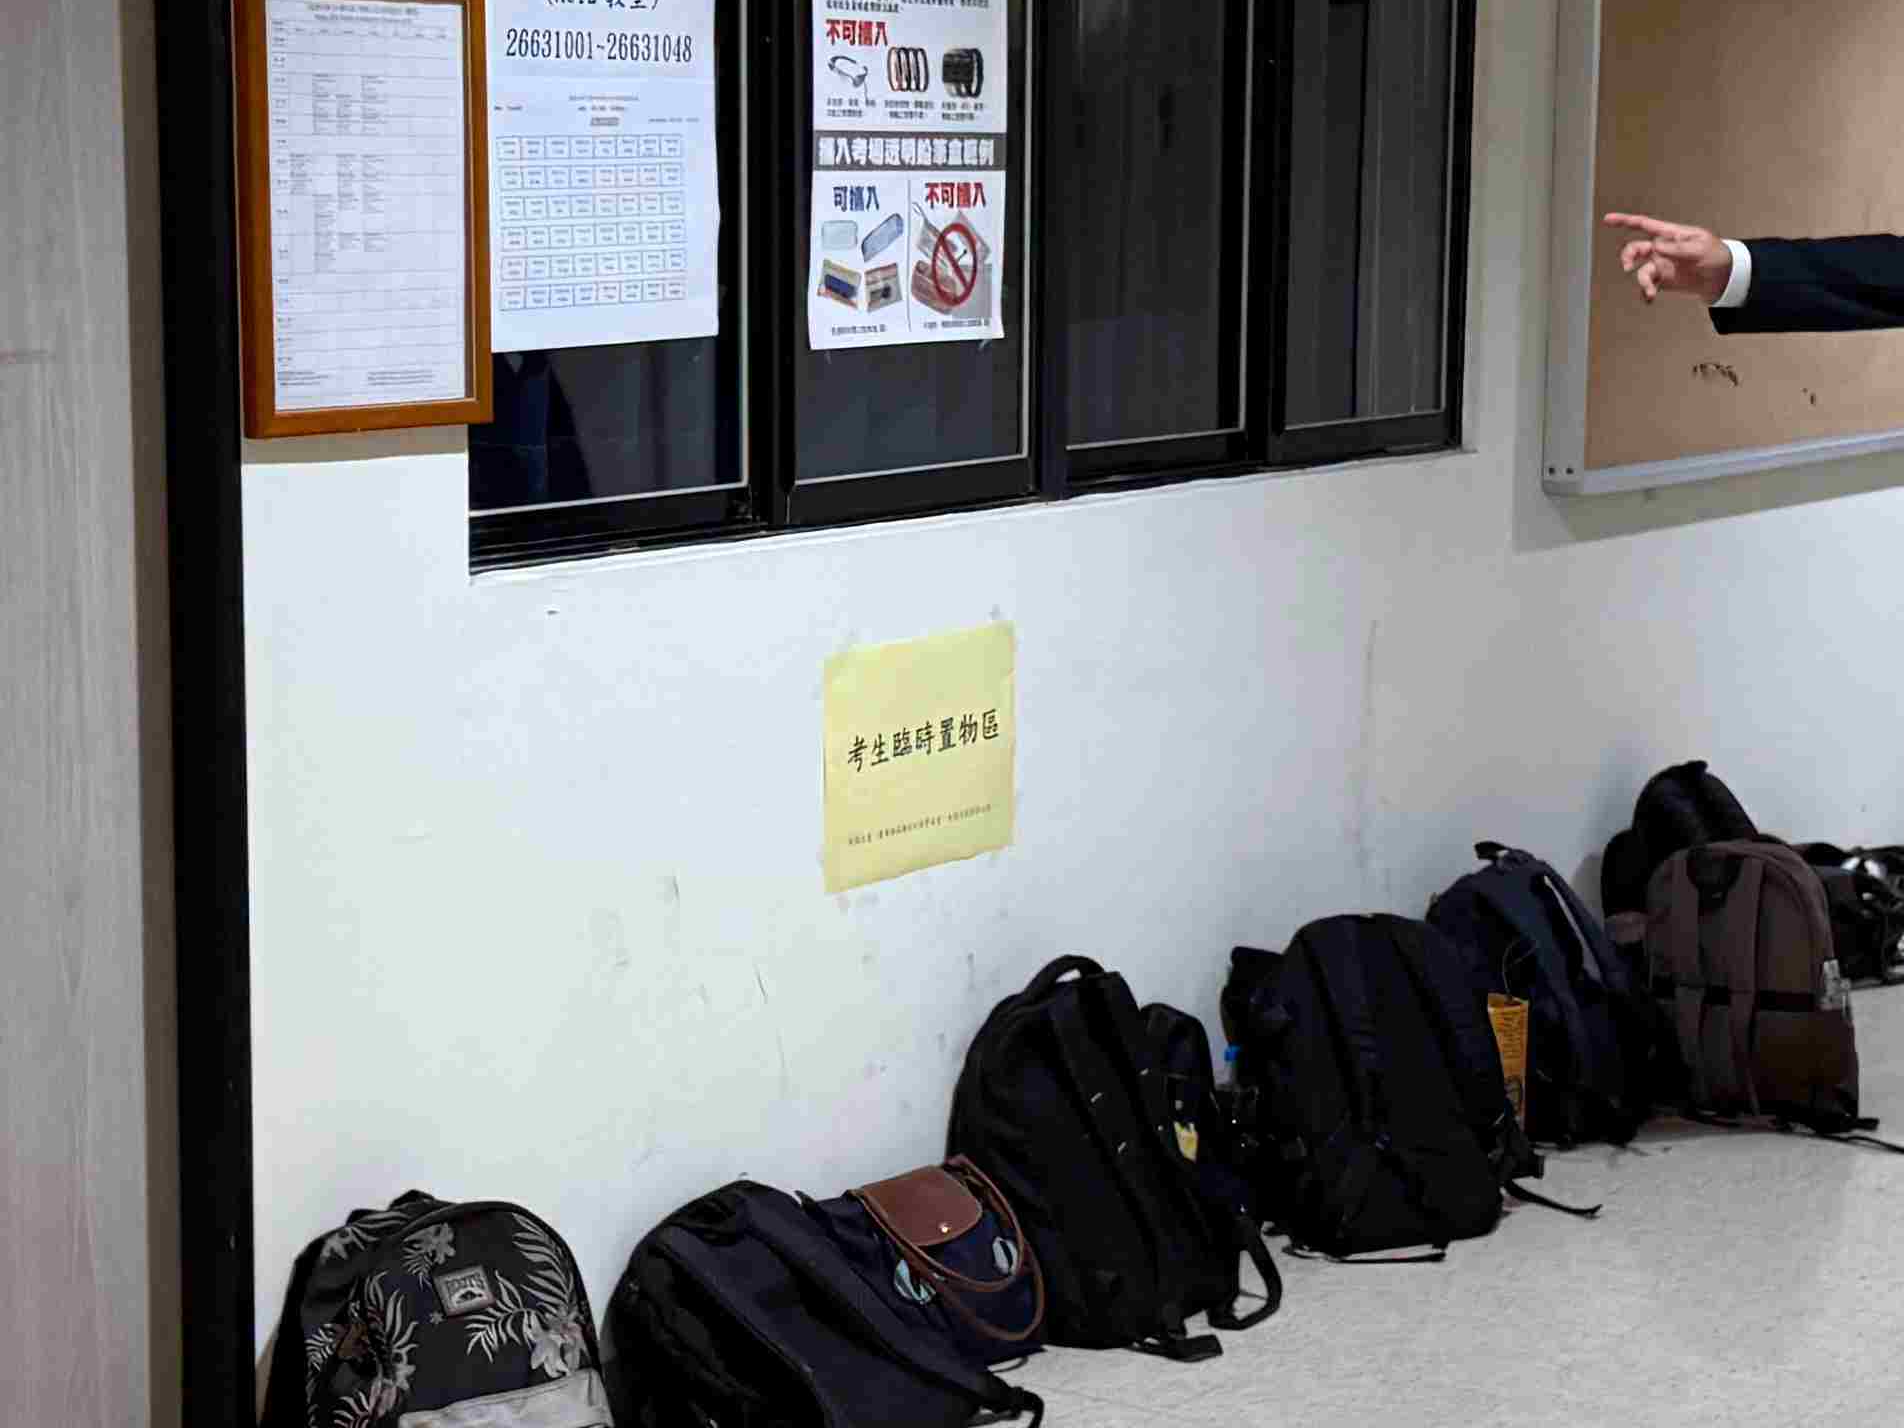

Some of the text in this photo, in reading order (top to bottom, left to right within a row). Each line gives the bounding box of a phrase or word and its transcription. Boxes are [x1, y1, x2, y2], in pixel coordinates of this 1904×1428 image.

[847, 708, 1000, 773] 考生臨時置物區
